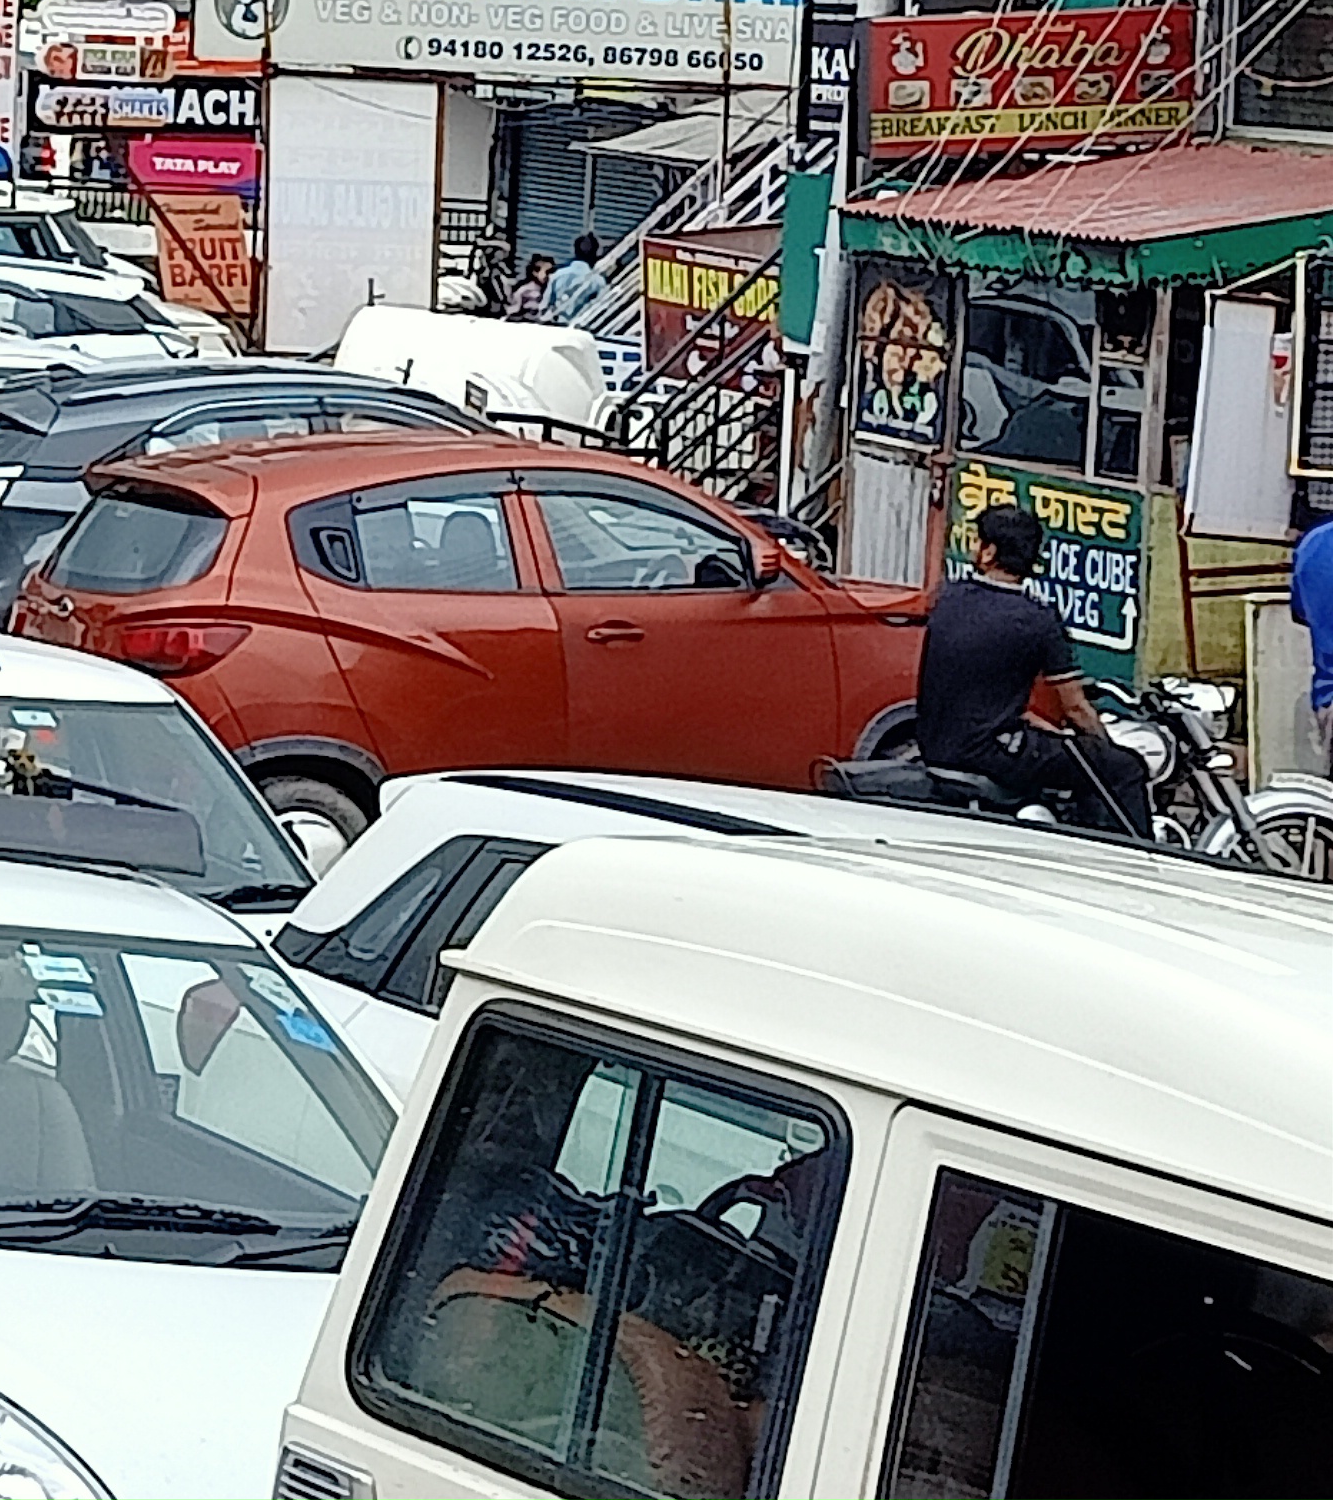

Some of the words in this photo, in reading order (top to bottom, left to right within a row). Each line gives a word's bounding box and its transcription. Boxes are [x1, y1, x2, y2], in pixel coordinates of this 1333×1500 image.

[379, 1, 401, 26] &
[486, 6, 544, 32] VEG
[551, 8, 628, 34] FOOD
[636, 13, 659, 36] &
[665, 14, 728, 40] LIVE
[427, 37, 504, 61] 94180
[603, 46, 679, 68] 86798
[953, 27, 1129, 77] Dhaba
[880, 114, 1001, 139] BREAKFAST
[1018, 110, 1088, 135] LUNCH
[152, 156, 195, 173] TATA
[197, 159, 242, 176] PLAY
[164, 237, 242, 262] FRUIT
[169, 263, 248, 288] BARFI
[693, 266, 730, 311] FISH
[1085, 549, 1137, 595] CUBE
